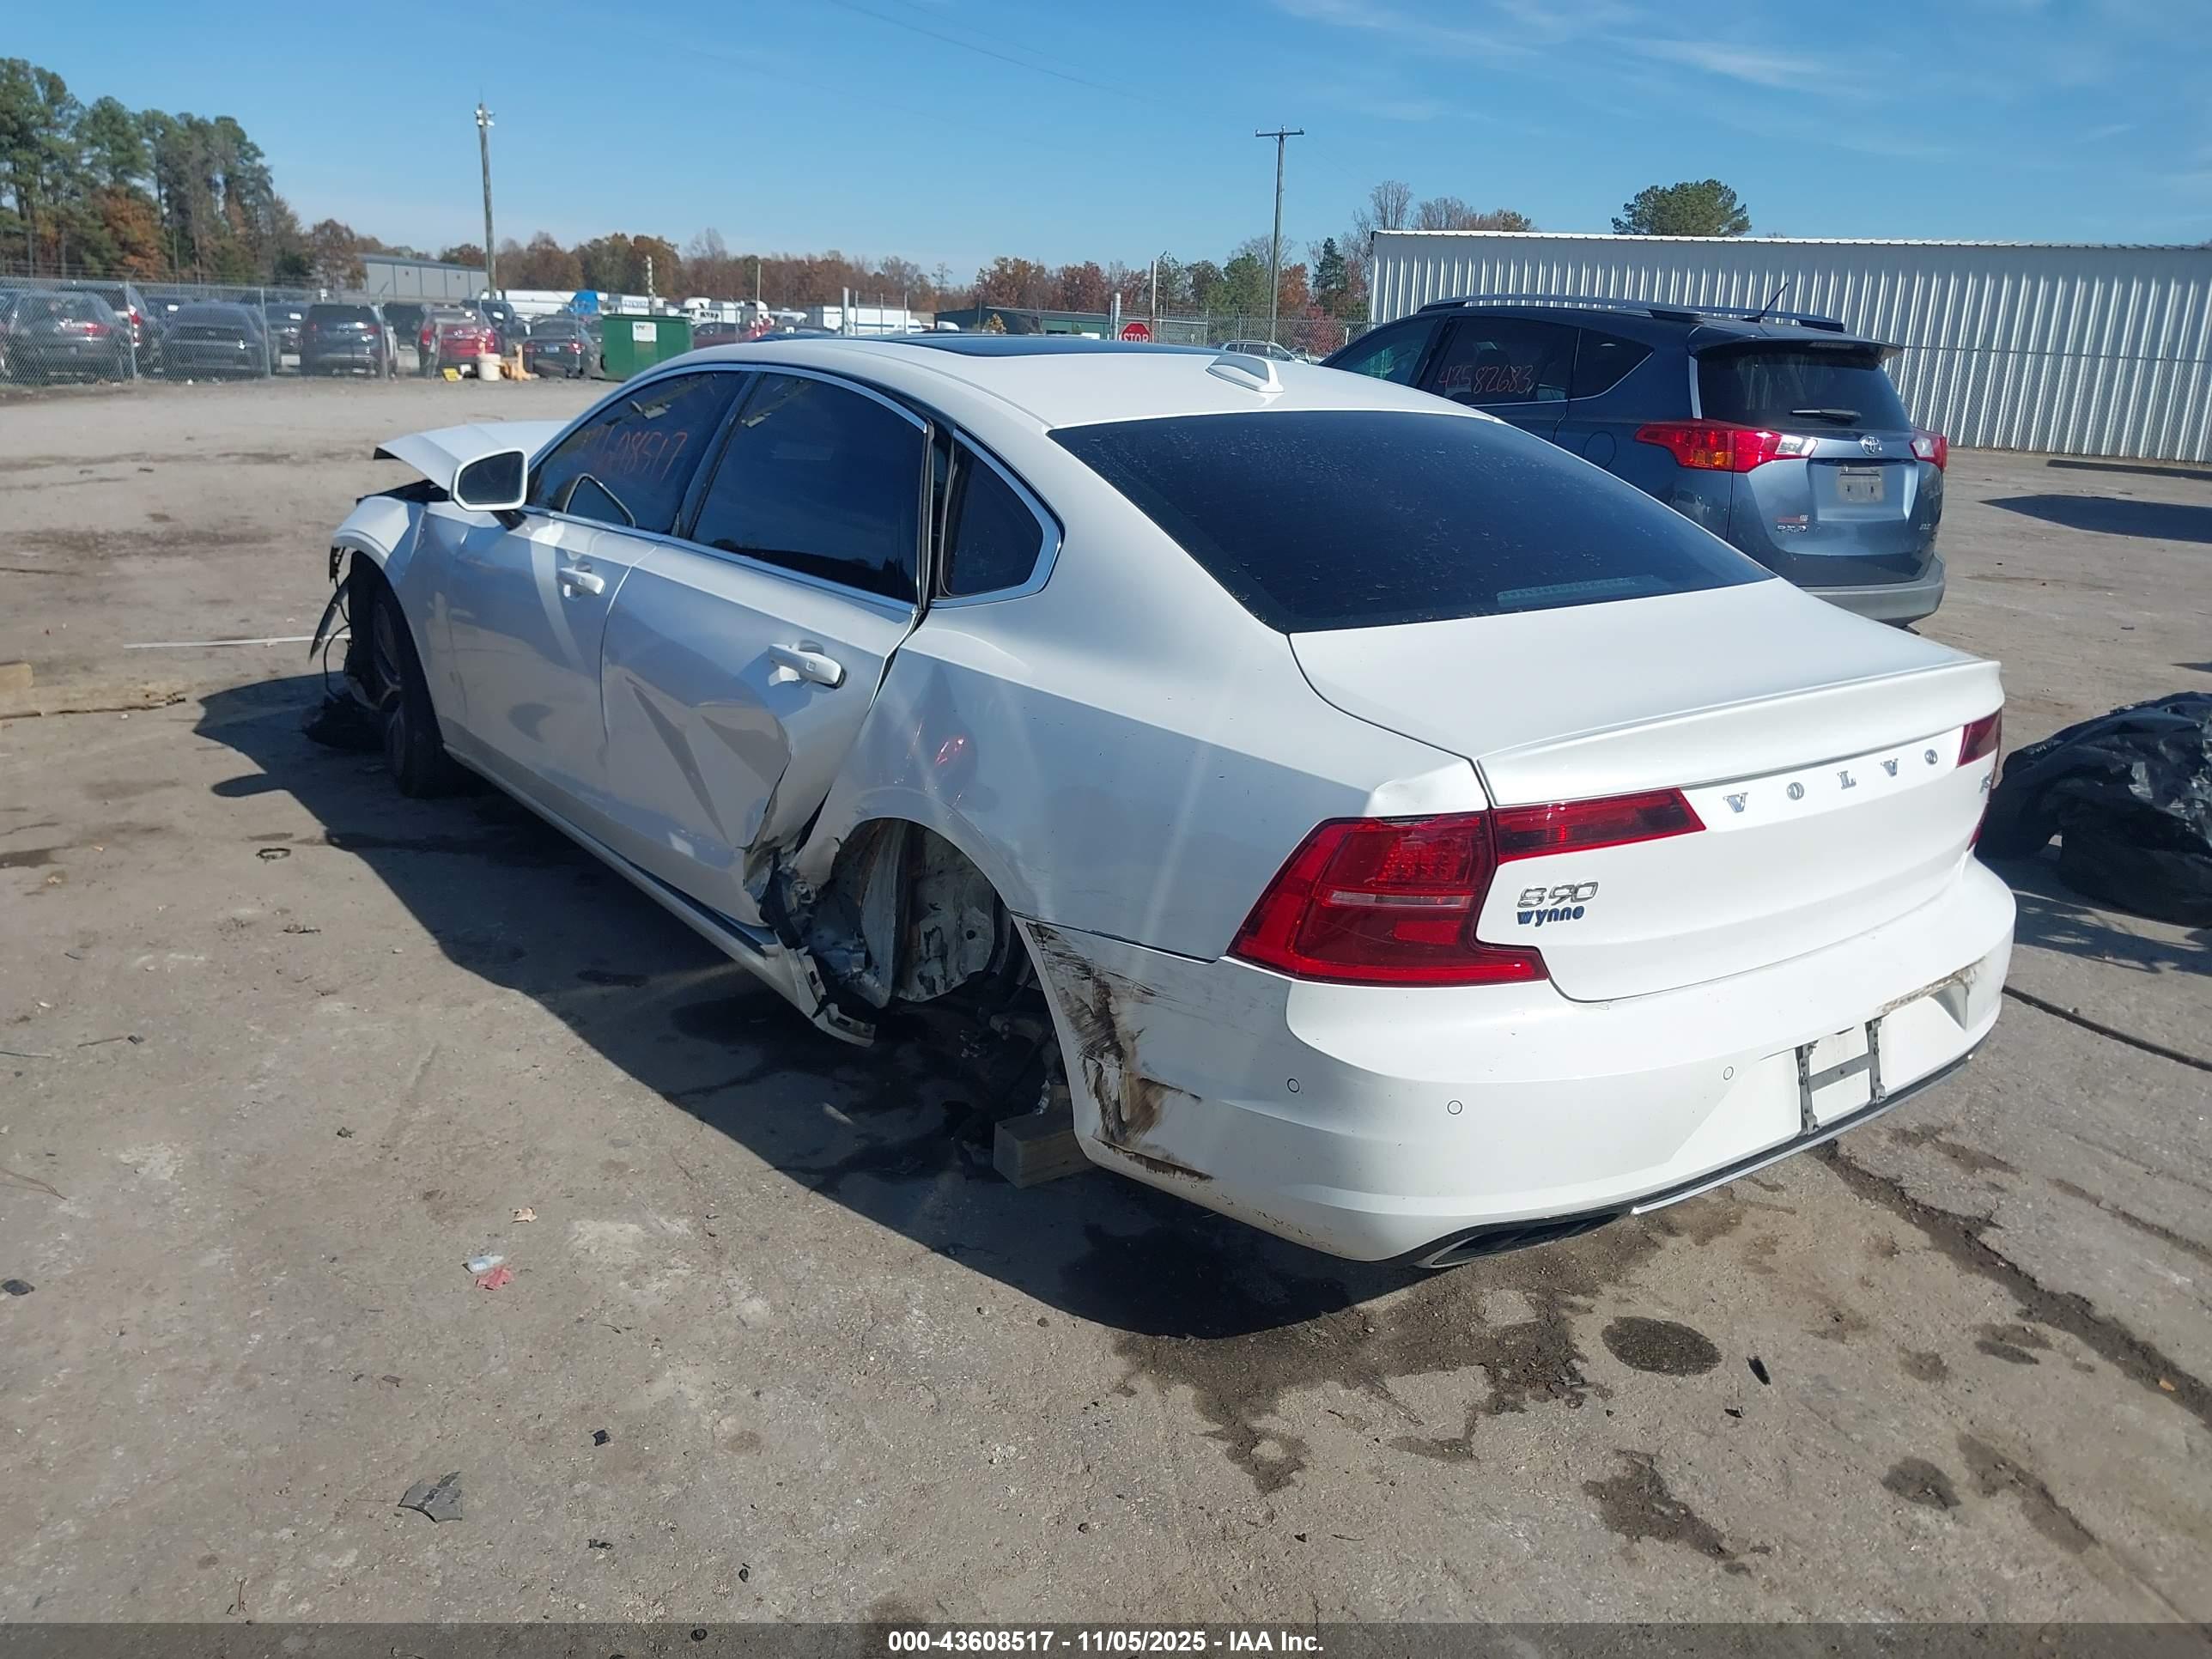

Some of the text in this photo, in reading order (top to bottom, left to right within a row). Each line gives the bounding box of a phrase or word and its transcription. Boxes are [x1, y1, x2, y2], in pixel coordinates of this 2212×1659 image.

[1123, 332, 1149, 343] STOP
[1723, 748, 1938, 814] VOLVO
[1516, 881, 1599, 908] S90
